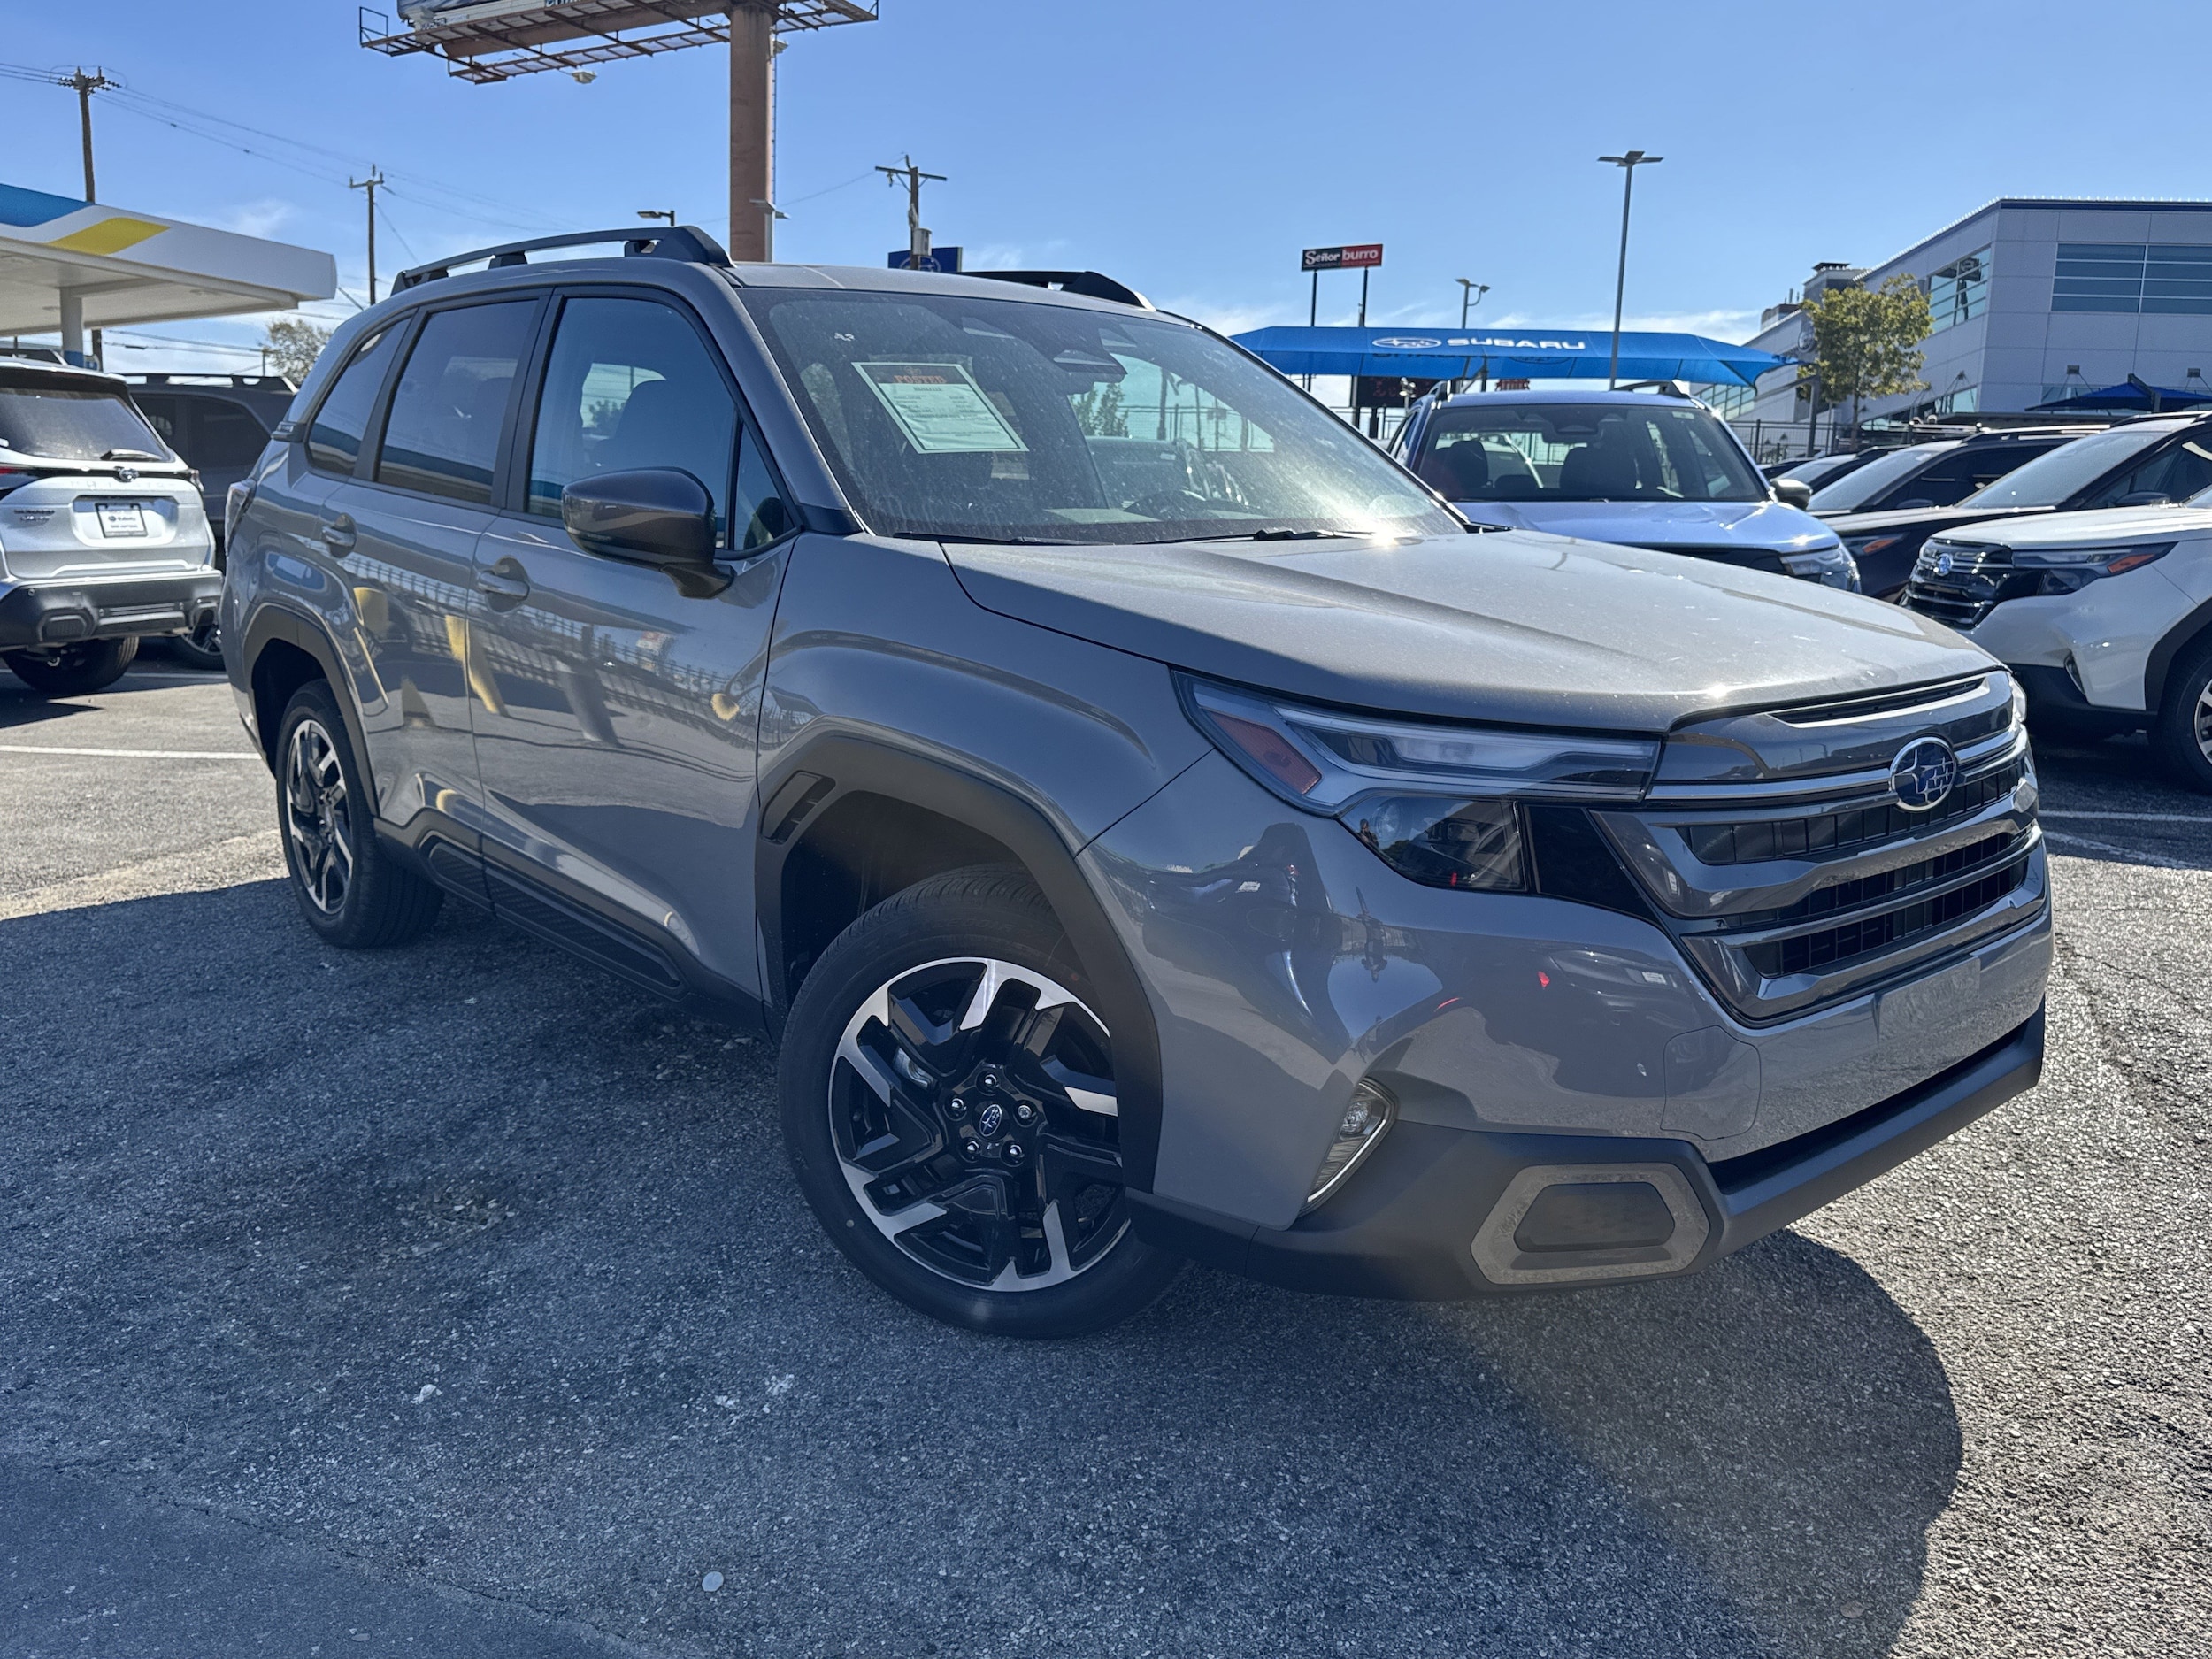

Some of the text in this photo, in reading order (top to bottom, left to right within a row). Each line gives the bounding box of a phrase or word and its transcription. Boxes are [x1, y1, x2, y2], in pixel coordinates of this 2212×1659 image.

[1305, 250, 1379, 265] Señor burro
[1447, 338, 1586, 349] SUBARU
